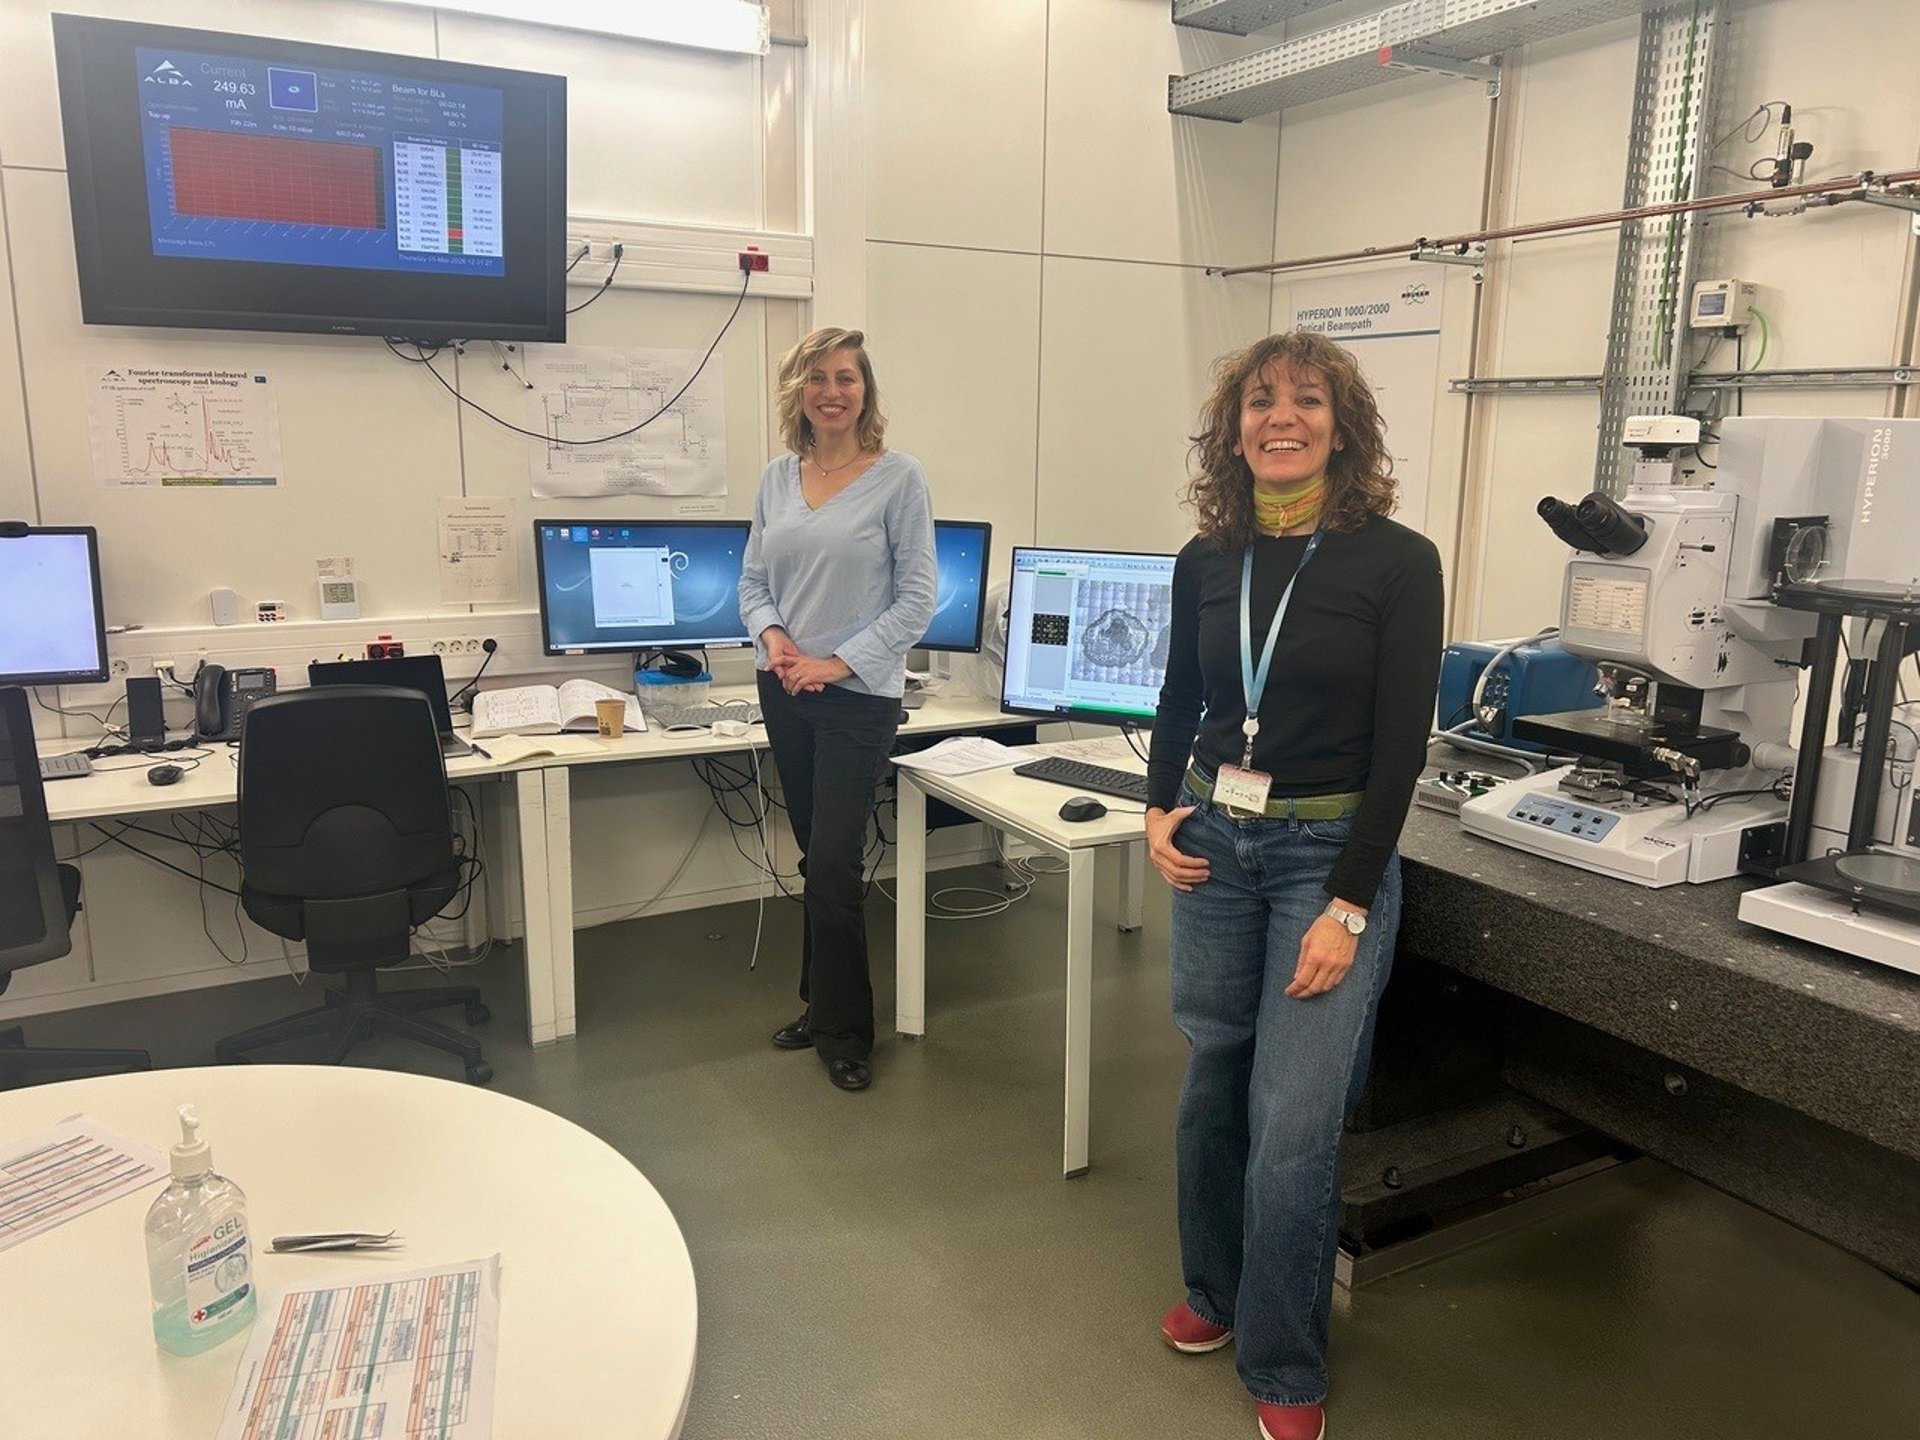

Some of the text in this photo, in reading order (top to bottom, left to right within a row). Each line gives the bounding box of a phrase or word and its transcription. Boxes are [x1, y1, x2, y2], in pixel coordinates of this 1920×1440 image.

[200, 62, 246, 78] Current
[144, 76, 192, 87] ALBA
[213, 80, 256, 96] 249.63
[392, 84, 416, 95] Beam
[417, 87, 429, 97] for
[225, 99, 247, 111] mA
[1297, 303, 1390, 321] HYPERION 1000/2000
[1327, 318, 1372, 332] Beampath
[128, 369, 248, 379] Fourier transformed infrared
[138, 377, 240, 388] spectroscopy and biology
[1882, 428, 1893, 461] 3000
[1861, 428, 1883, 524] HYPERION
[213, 1218, 242, 1240] GEL
